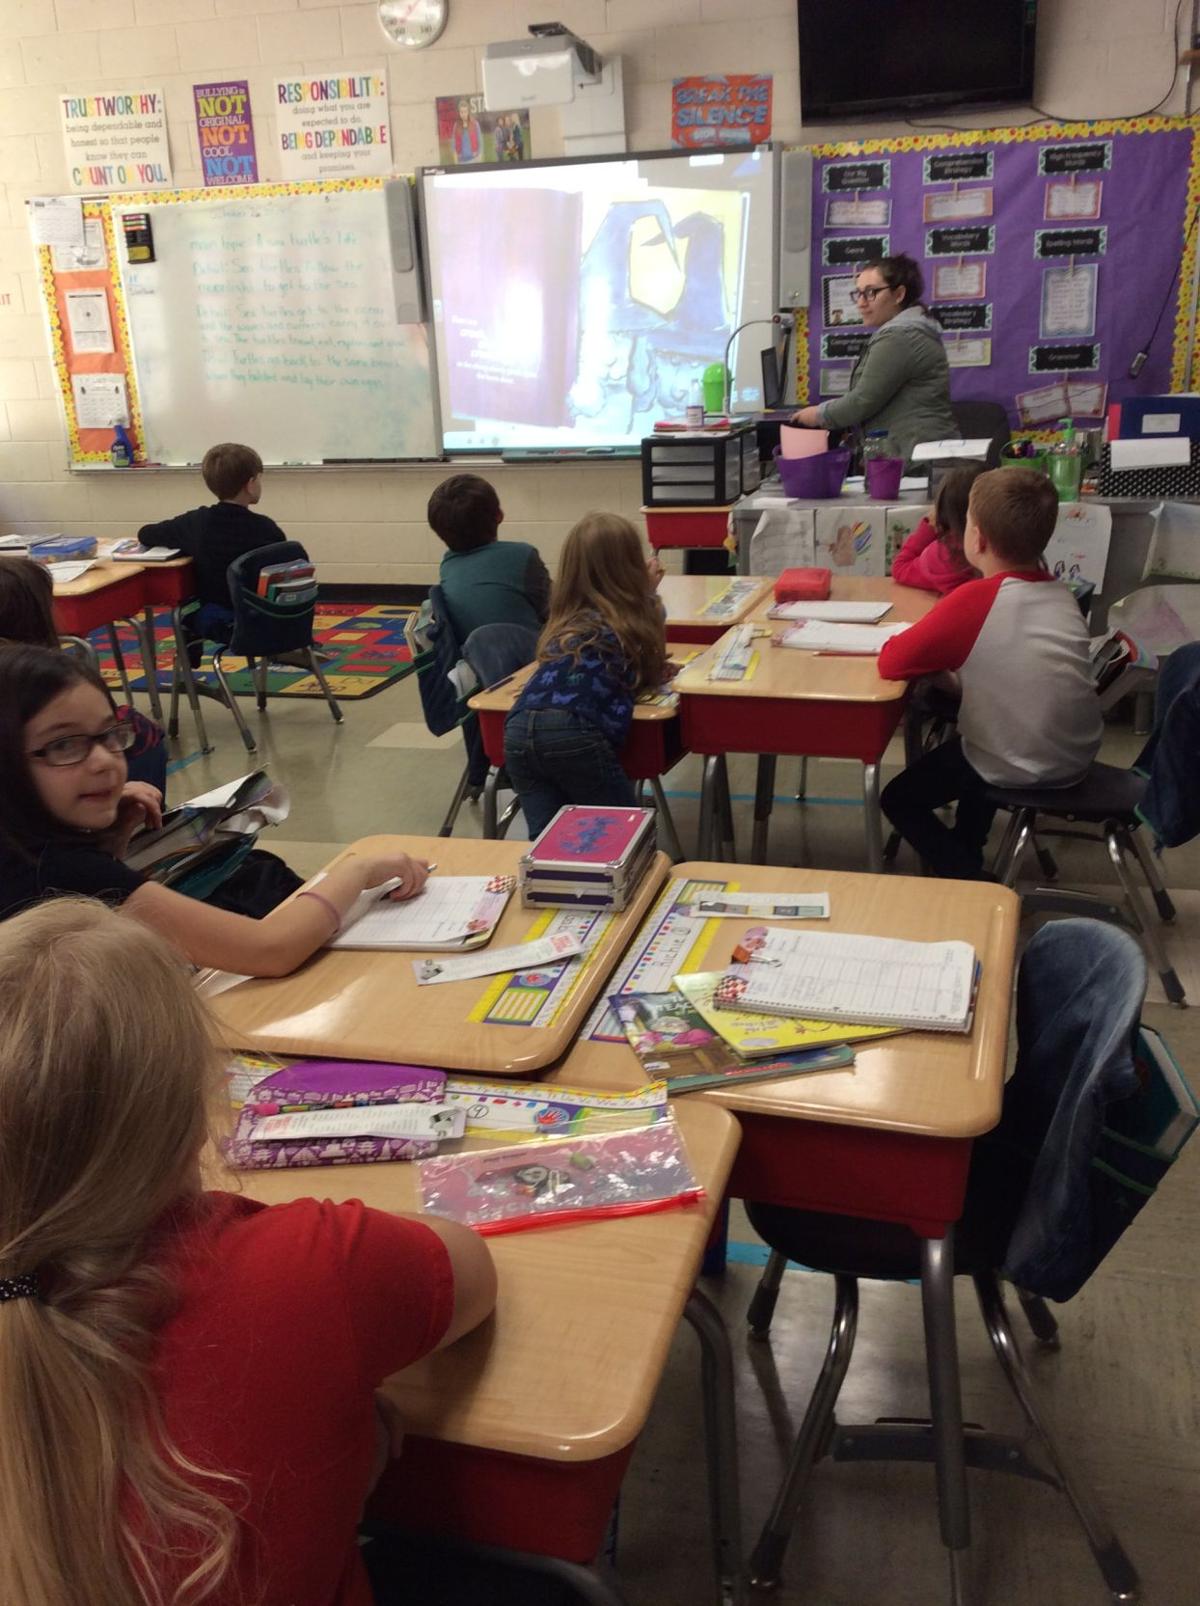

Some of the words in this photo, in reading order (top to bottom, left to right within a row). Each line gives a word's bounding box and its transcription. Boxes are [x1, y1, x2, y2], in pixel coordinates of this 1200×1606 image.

[278, 76, 385, 104] RESPONSIBILITY:
[677, 86, 731, 104] BREAK
[62, 93, 163, 119] TRUSTWORTHY:
[198, 95, 246, 117] NOT
[293, 107, 315, 115] doing
[318, 103, 338, 112] what
[340, 104, 356, 113] you
[677, 105, 768, 127] SILENCE
[66, 123, 89, 135] being
[91, 120, 143, 132] dependable
[144, 118, 163, 129] and
[302, 117, 339, 127] expected
[71, 137, 98, 147] honest
[111, 136, 129, 146] that
[130, 134, 161, 147] people
[200, 124, 249, 146] NOT
[281, 131, 313, 151] BEING
[315, 125, 387, 149] DEPENDABLE
[85, 151, 107, 161] know
[109, 150, 129, 162] they
[130, 150, 148, 159] can
[205, 155, 253, 177] NOT
[72, 164, 114, 186] COUNT
[117, 163, 136, 184] ON
[137, 162, 168, 184] YOU.
